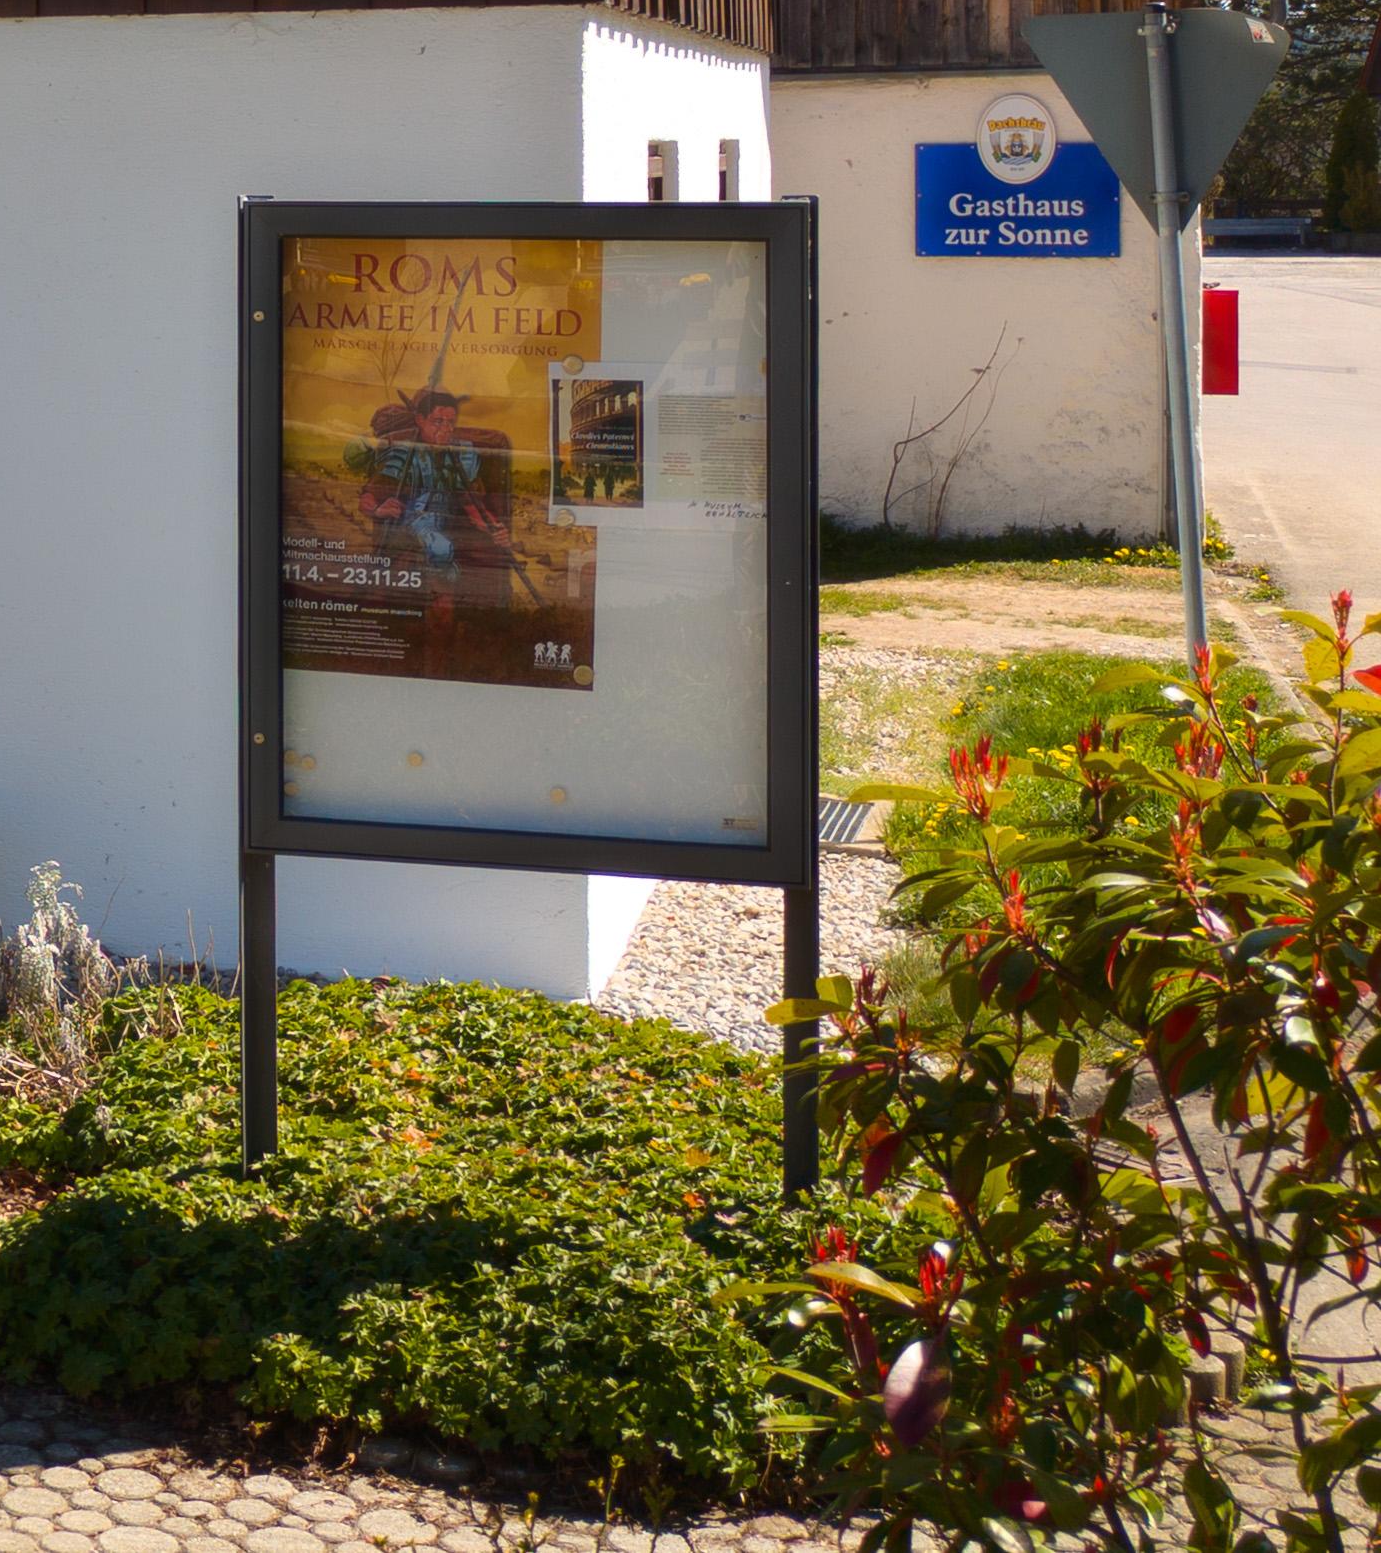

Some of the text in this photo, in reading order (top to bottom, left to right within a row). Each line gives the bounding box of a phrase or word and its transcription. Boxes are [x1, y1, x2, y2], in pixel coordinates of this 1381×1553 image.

[948, 193, 1085, 217] Gasthaus
[944, 221, 1089, 245] zur Sonne
[351, 253, 518, 297] ROMS
[288, 302, 583, 337] ARMEE IM FELD
[451, 343, 558, 357] VERSORGUNG
[324, 539, 345, 550] und
[282, 564, 324, 582] 11.4.
[342, 567, 422, 588] 23.11.25
[320, 600, 358, 612] römer
